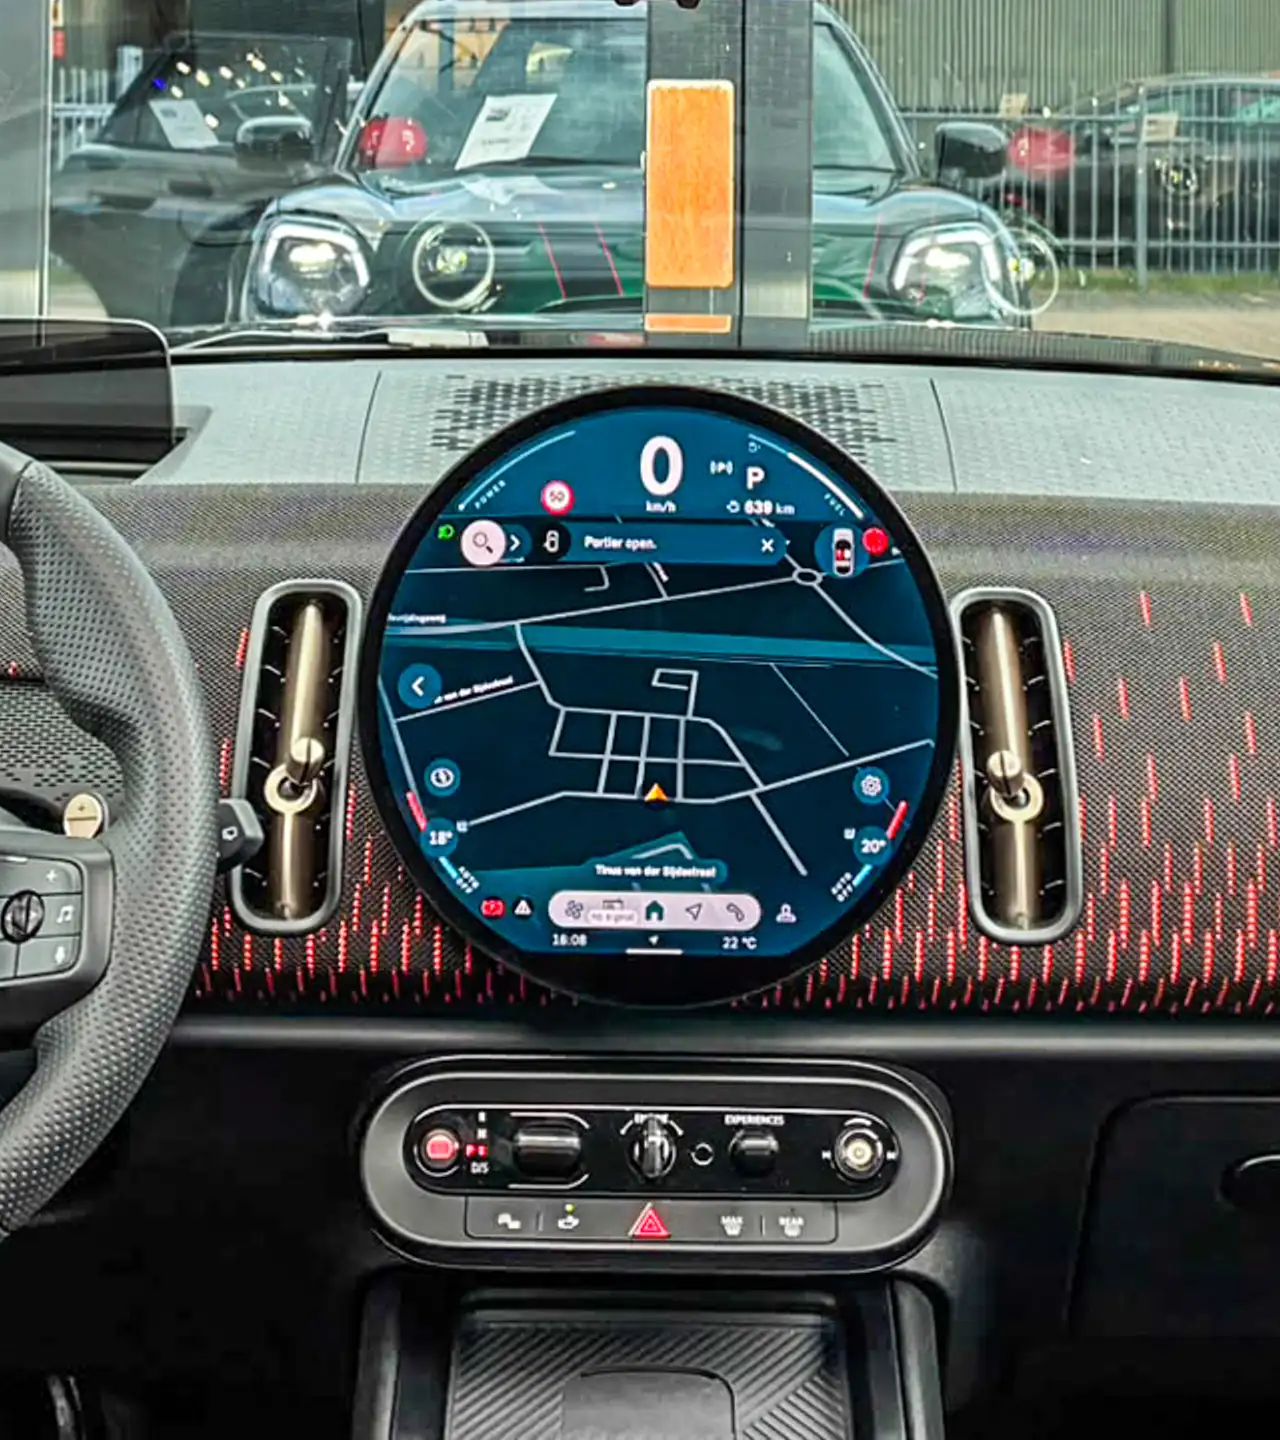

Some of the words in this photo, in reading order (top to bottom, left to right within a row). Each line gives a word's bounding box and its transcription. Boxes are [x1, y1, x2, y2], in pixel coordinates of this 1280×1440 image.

[640, 436, 684, 496] 0
[746, 466, 765, 489] P
[645, 500, 677, 513] km/h
[775, 502, 796, 515] km
[823, 492, 846, 517] FUEL
[584, 535, 623, 549] Portier
[861, 838, 887, 853] 20°
[722, 936, 739, 950] 22
[741, 936, 758, 950] °C
